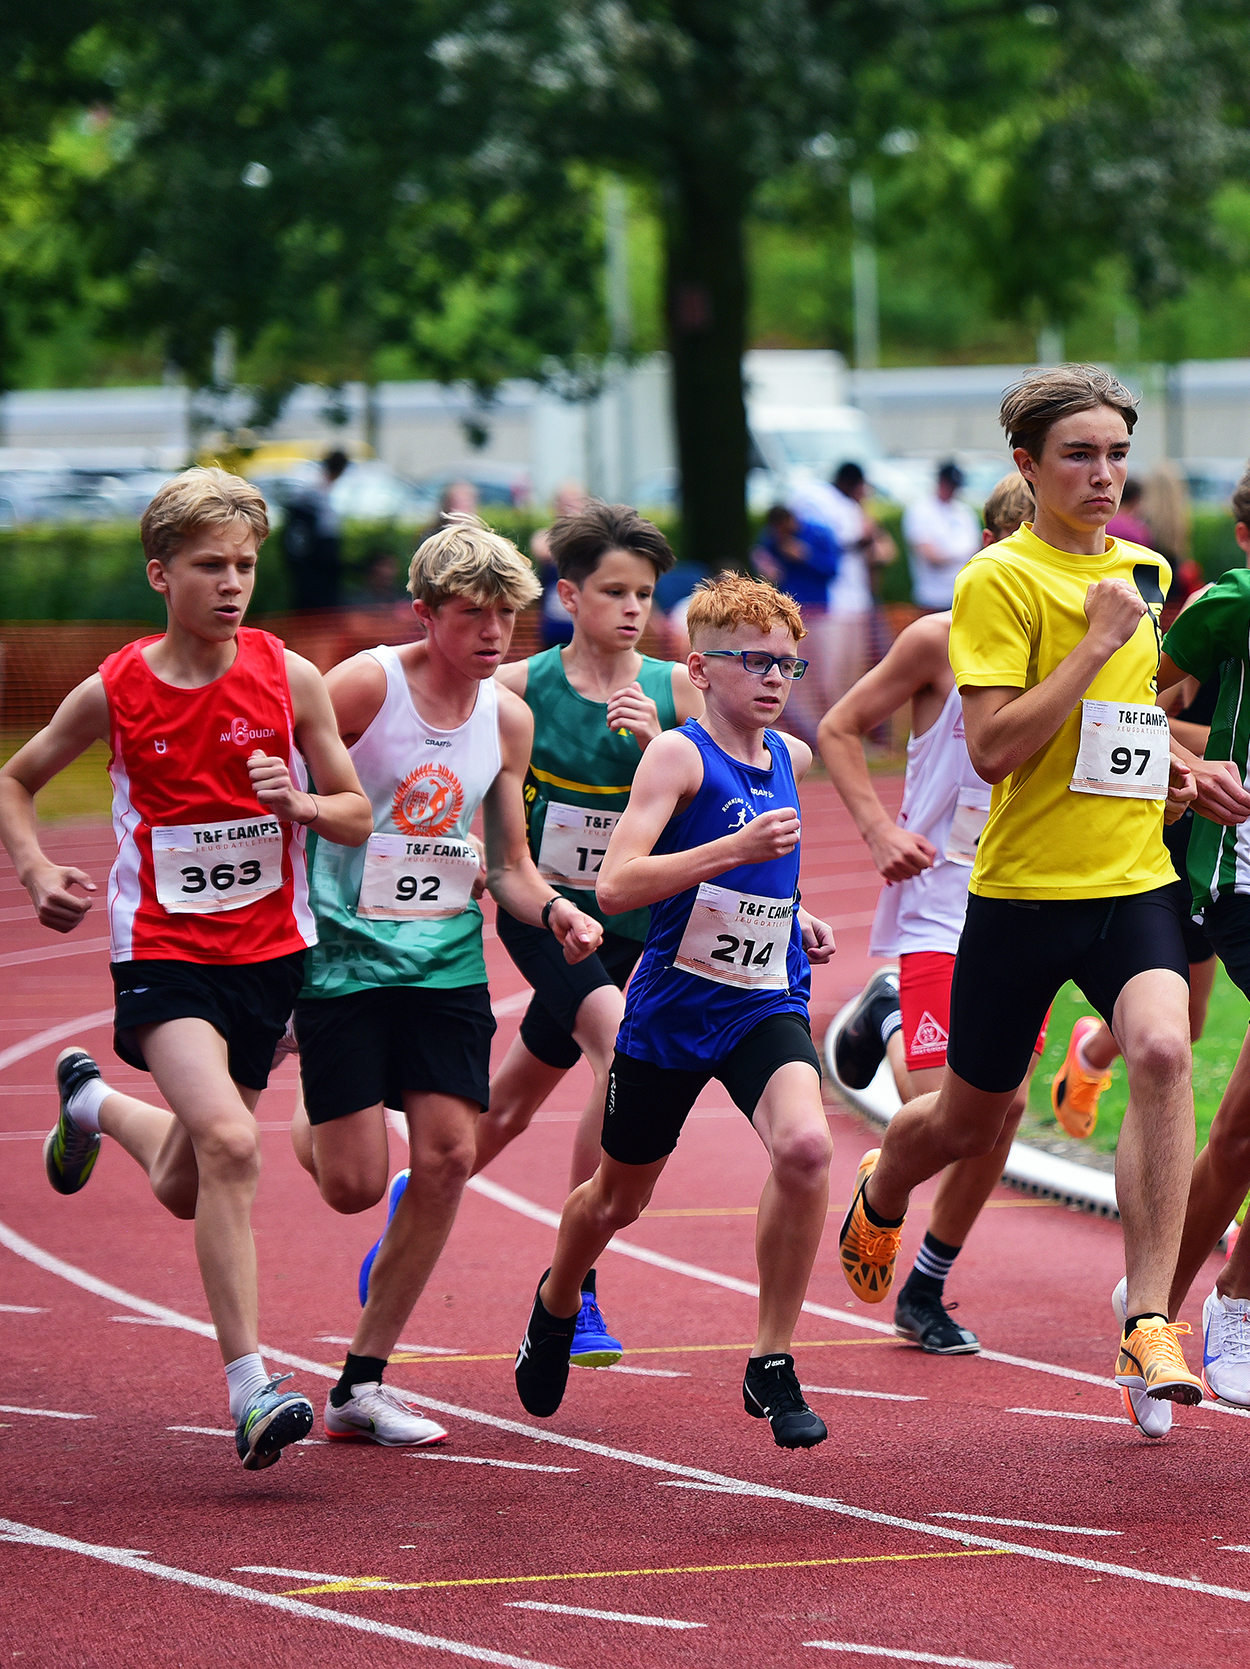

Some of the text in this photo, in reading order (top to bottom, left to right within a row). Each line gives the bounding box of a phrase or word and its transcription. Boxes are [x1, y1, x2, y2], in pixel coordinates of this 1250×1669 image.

[1118, 710, 1138, 725] T&F
[1140, 712, 1168, 728] CAMPS
[220, 732, 231, 742] AV
[1116, 726, 1169, 736] JEUGDATLETIEK
[425, 738, 447, 747] CRAFT
[1109, 746, 1151, 776] 97
[721, 797, 744, 812] RUNNING
[584, 815, 612, 829] T&F
[193, 828, 222, 845] T&F
[226, 821, 279, 841] CAMPS
[195, 836, 280, 853] JEUGDATLETIEK
[405, 843, 431, 855] T&F
[433, 844, 477, 858] CAMPS
[403, 857, 476, 867] JEUGDATLETIEK
[179, 860, 262, 894] 363
[394, 875, 441, 901] 92
[738, 900, 766, 917] T&F
[325, 943, 380, 963] PAC
[710, 934, 775, 968] 214
